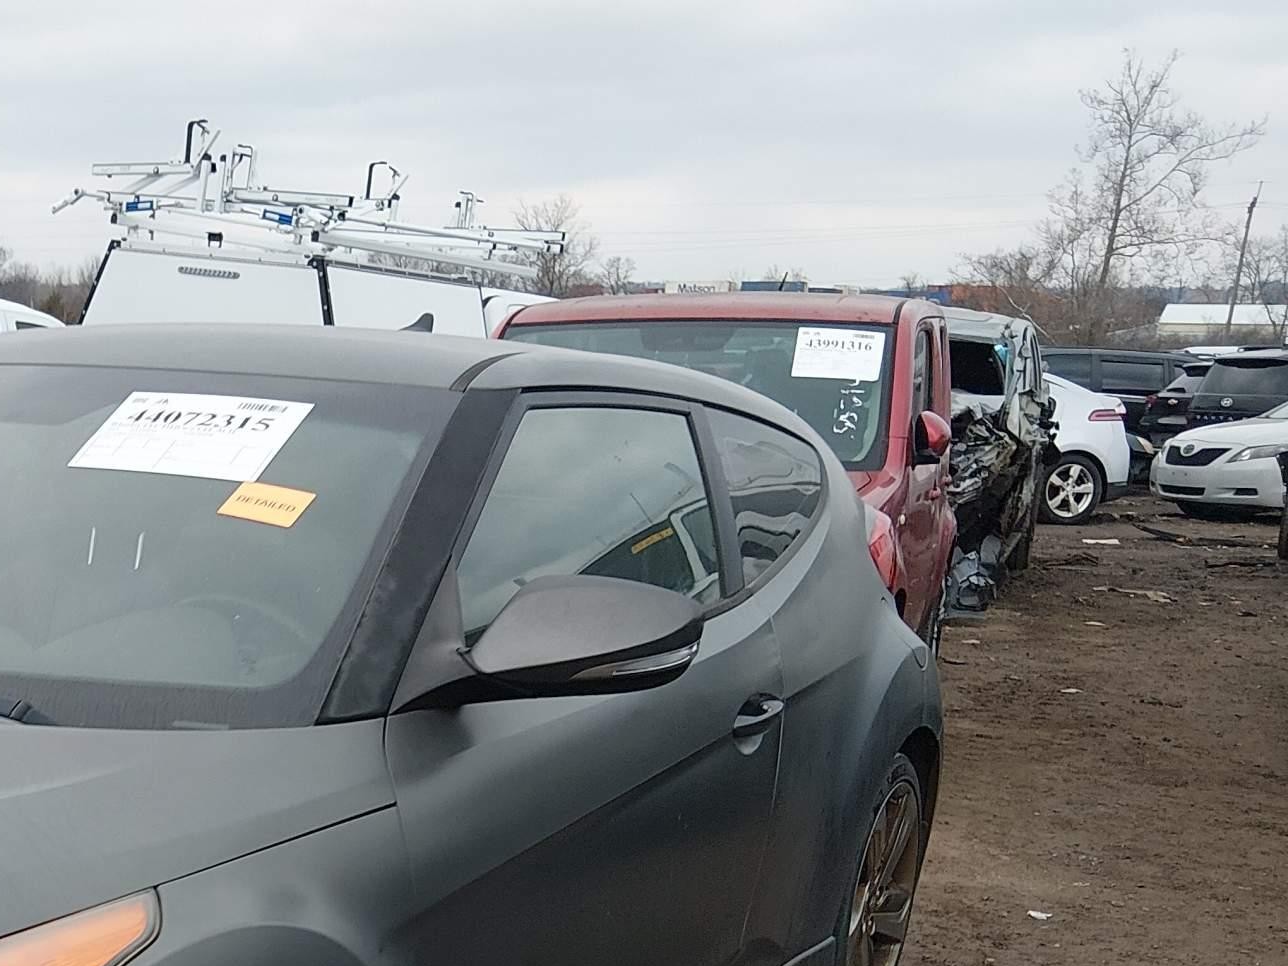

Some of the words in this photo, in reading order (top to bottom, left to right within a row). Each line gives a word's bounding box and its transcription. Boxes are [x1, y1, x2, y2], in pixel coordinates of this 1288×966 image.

[677, 283, 716, 294] Matson
[805, 338, 873, 352] 43991316
[127, 408, 275, 433] 44072315
[236, 494, 298, 513] DETAILED
